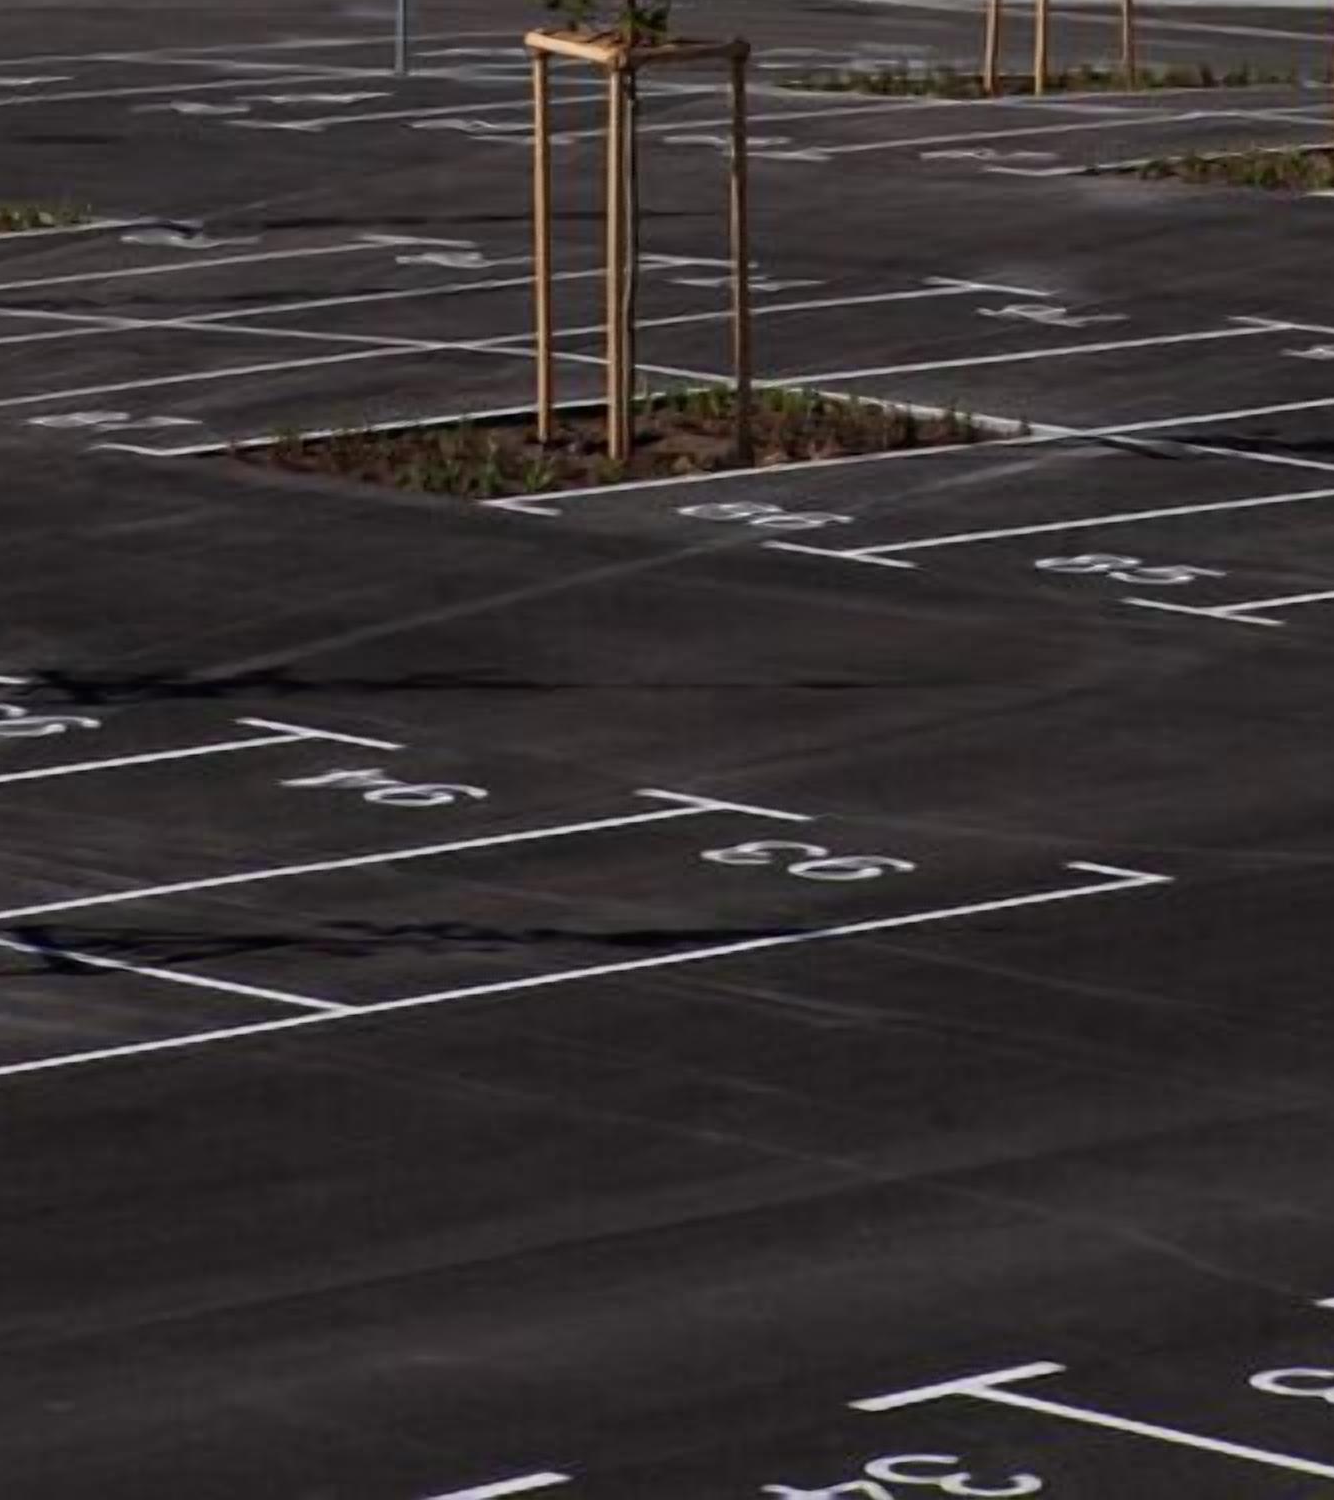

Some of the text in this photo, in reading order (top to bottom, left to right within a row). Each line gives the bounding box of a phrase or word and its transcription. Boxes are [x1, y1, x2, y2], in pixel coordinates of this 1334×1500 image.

[1034, 553, 1226, 586] 85
[279, 766, 489, 808] 94
[700, 839, 917, 882] 93
